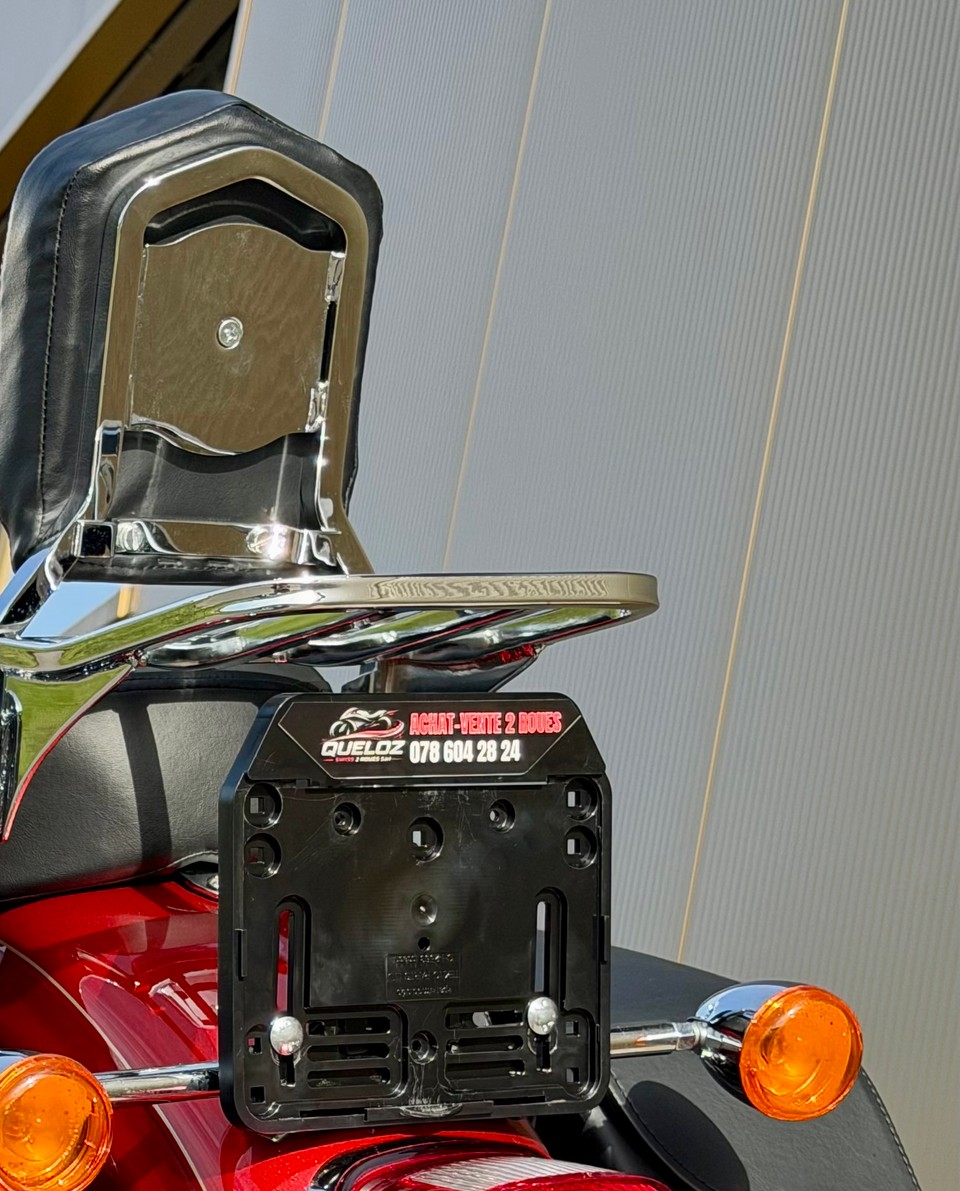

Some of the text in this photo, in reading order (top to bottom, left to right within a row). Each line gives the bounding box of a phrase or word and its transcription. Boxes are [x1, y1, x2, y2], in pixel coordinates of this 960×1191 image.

[409, 711, 562, 735] ACHAT-VENTE 2 ROUES
[320, 740, 406, 757] QUELOZ
[409, 739, 522, 763] 078 604 28 24
